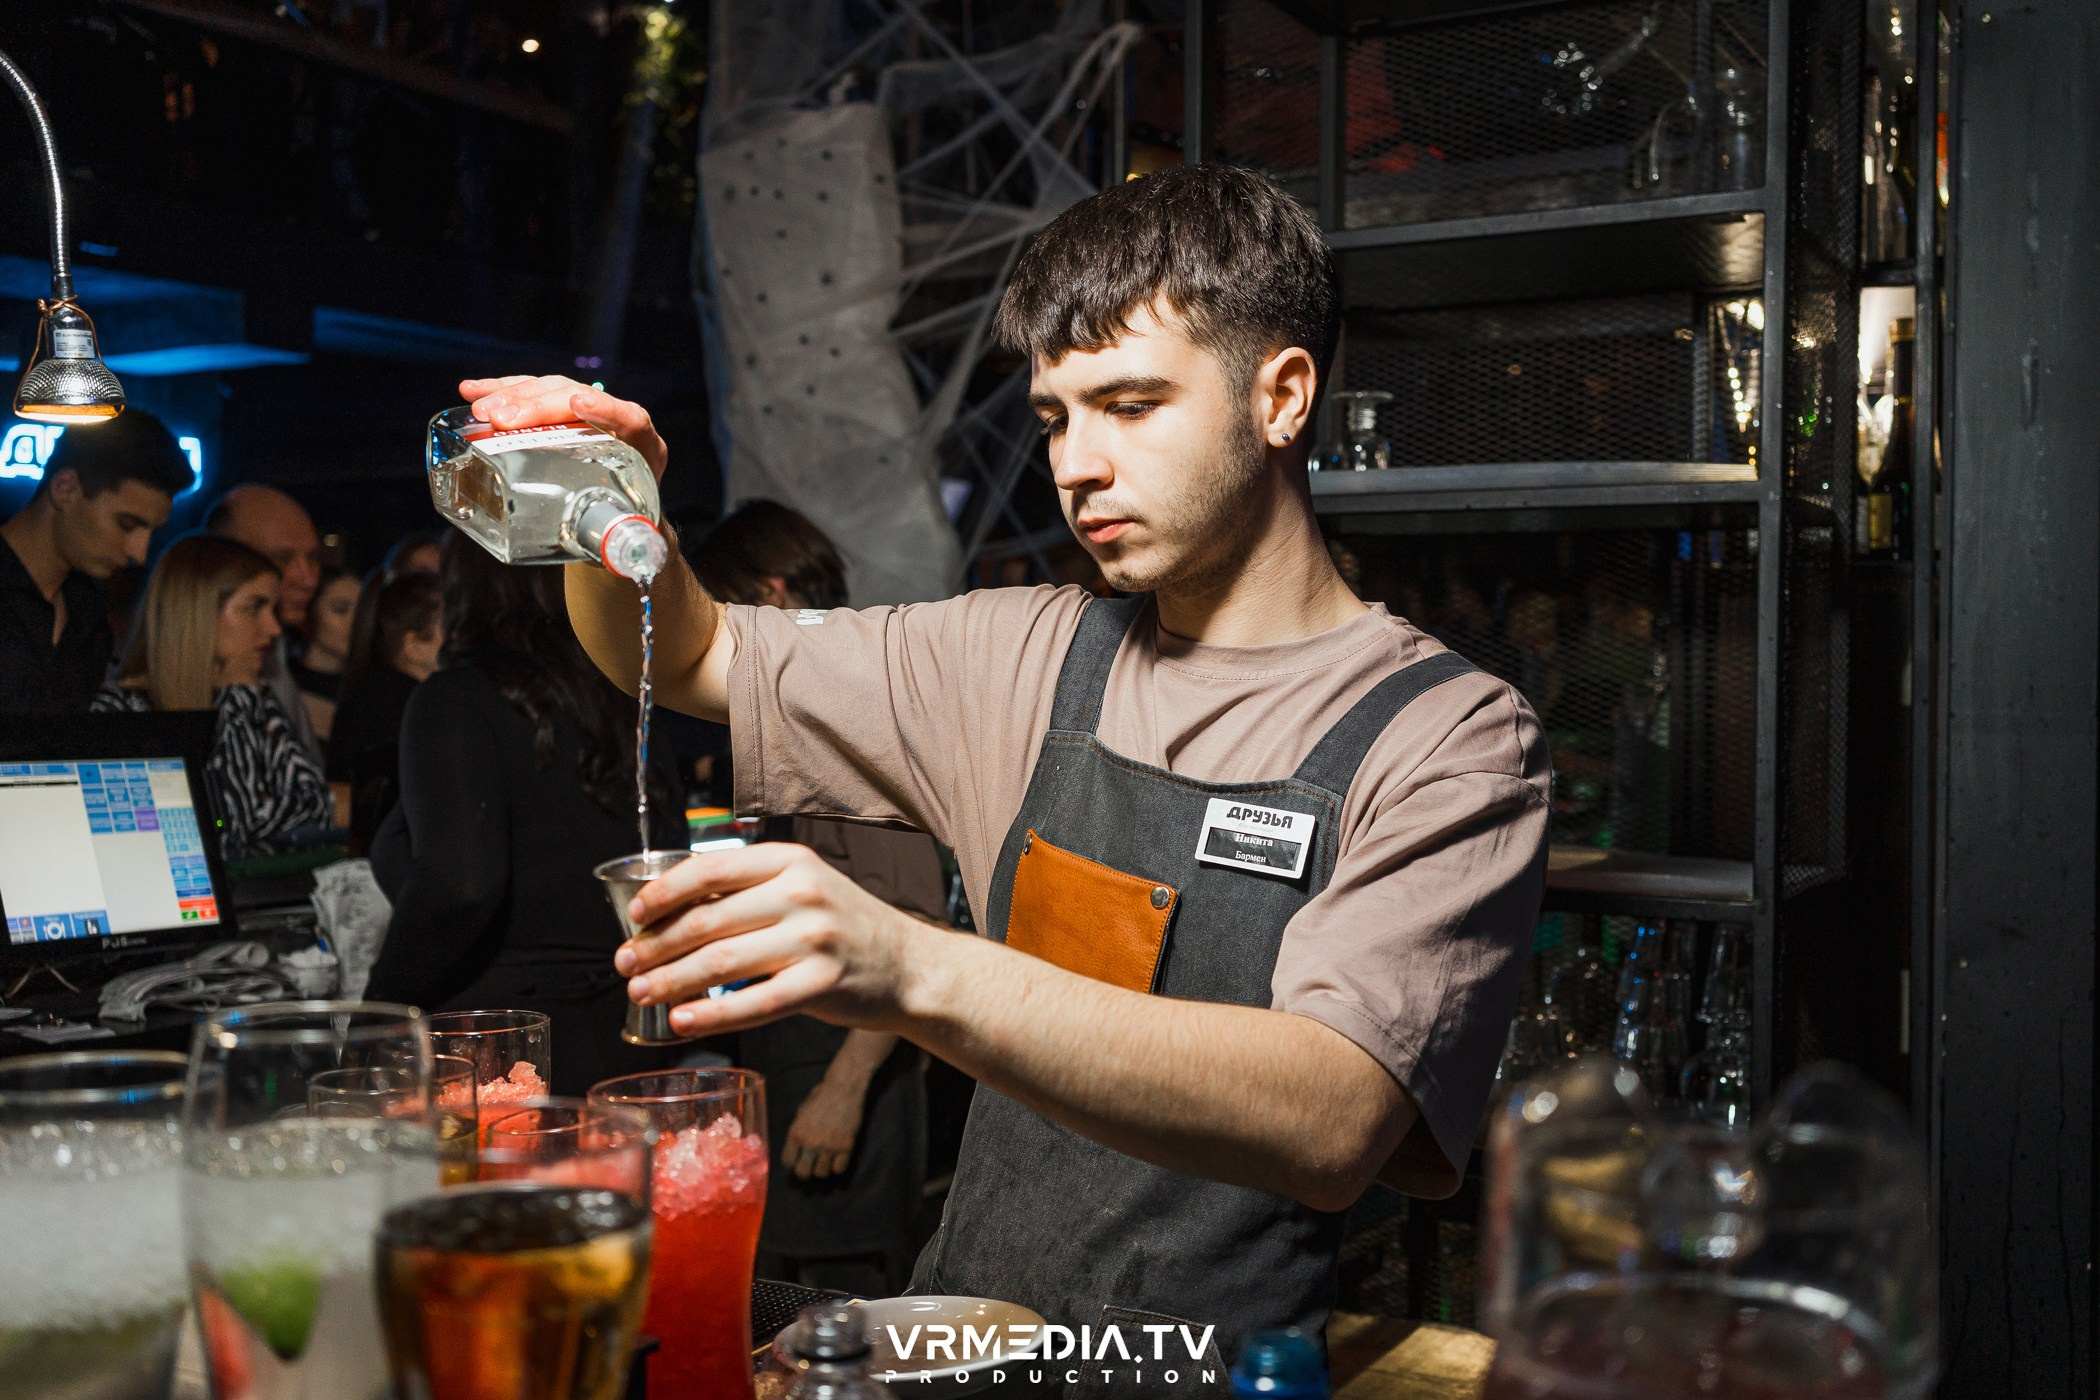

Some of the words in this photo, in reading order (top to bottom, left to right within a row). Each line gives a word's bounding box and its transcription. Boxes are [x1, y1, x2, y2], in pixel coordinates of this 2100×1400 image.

[493, 424, 568, 437] BLANCO
[1226, 806, 1293, 829] ДРУЗЬЯ
[1234, 833, 1274, 847] Никита
[1235, 850, 1267, 863] Бармен
